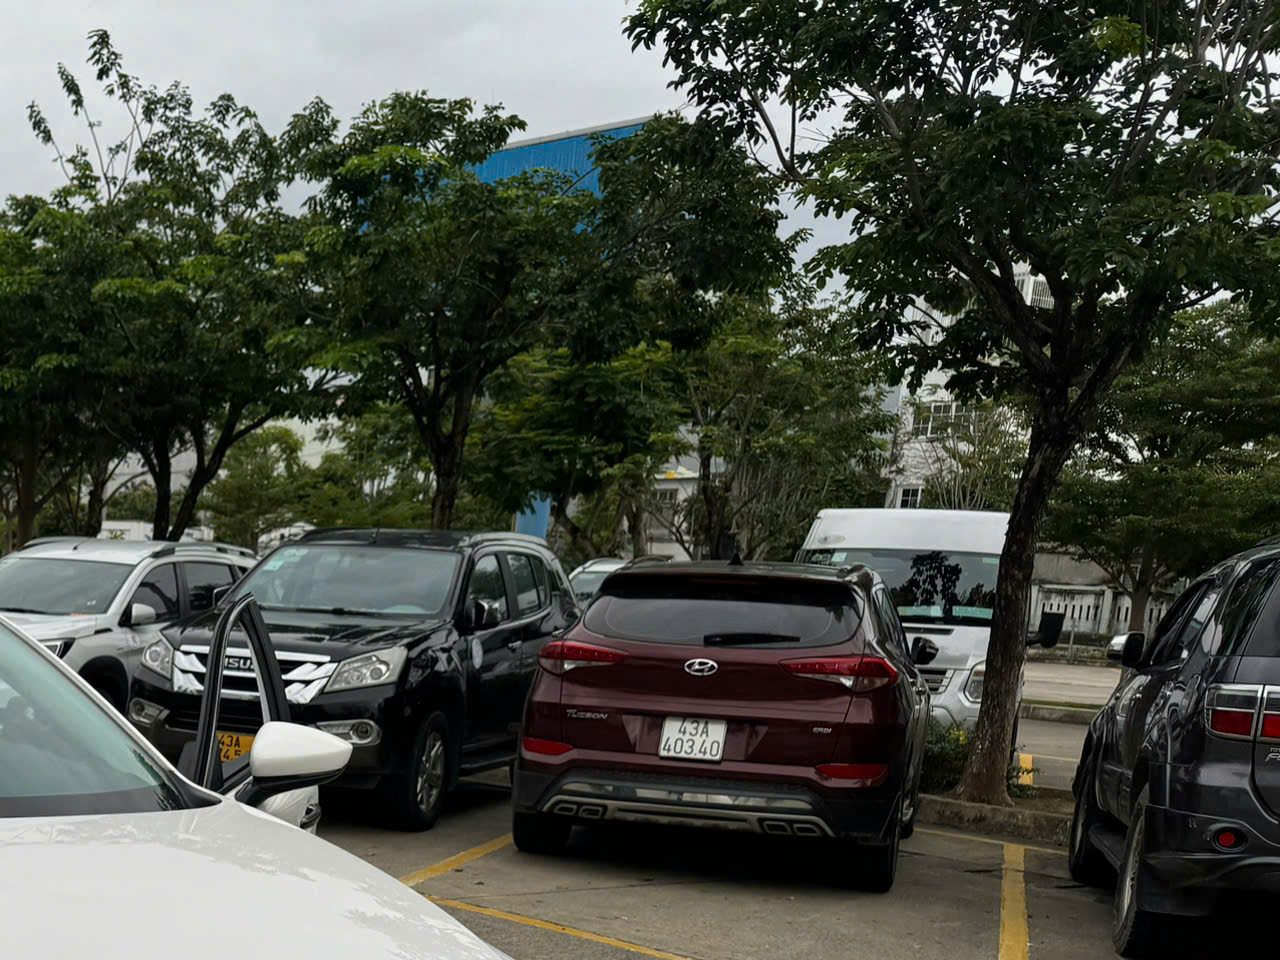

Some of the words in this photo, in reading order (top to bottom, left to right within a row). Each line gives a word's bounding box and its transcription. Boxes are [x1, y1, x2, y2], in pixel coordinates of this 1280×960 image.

[678, 719, 710, 739] 43A
[218, 734, 241, 749] 43A
[662, 737, 721, 758] 403.40
